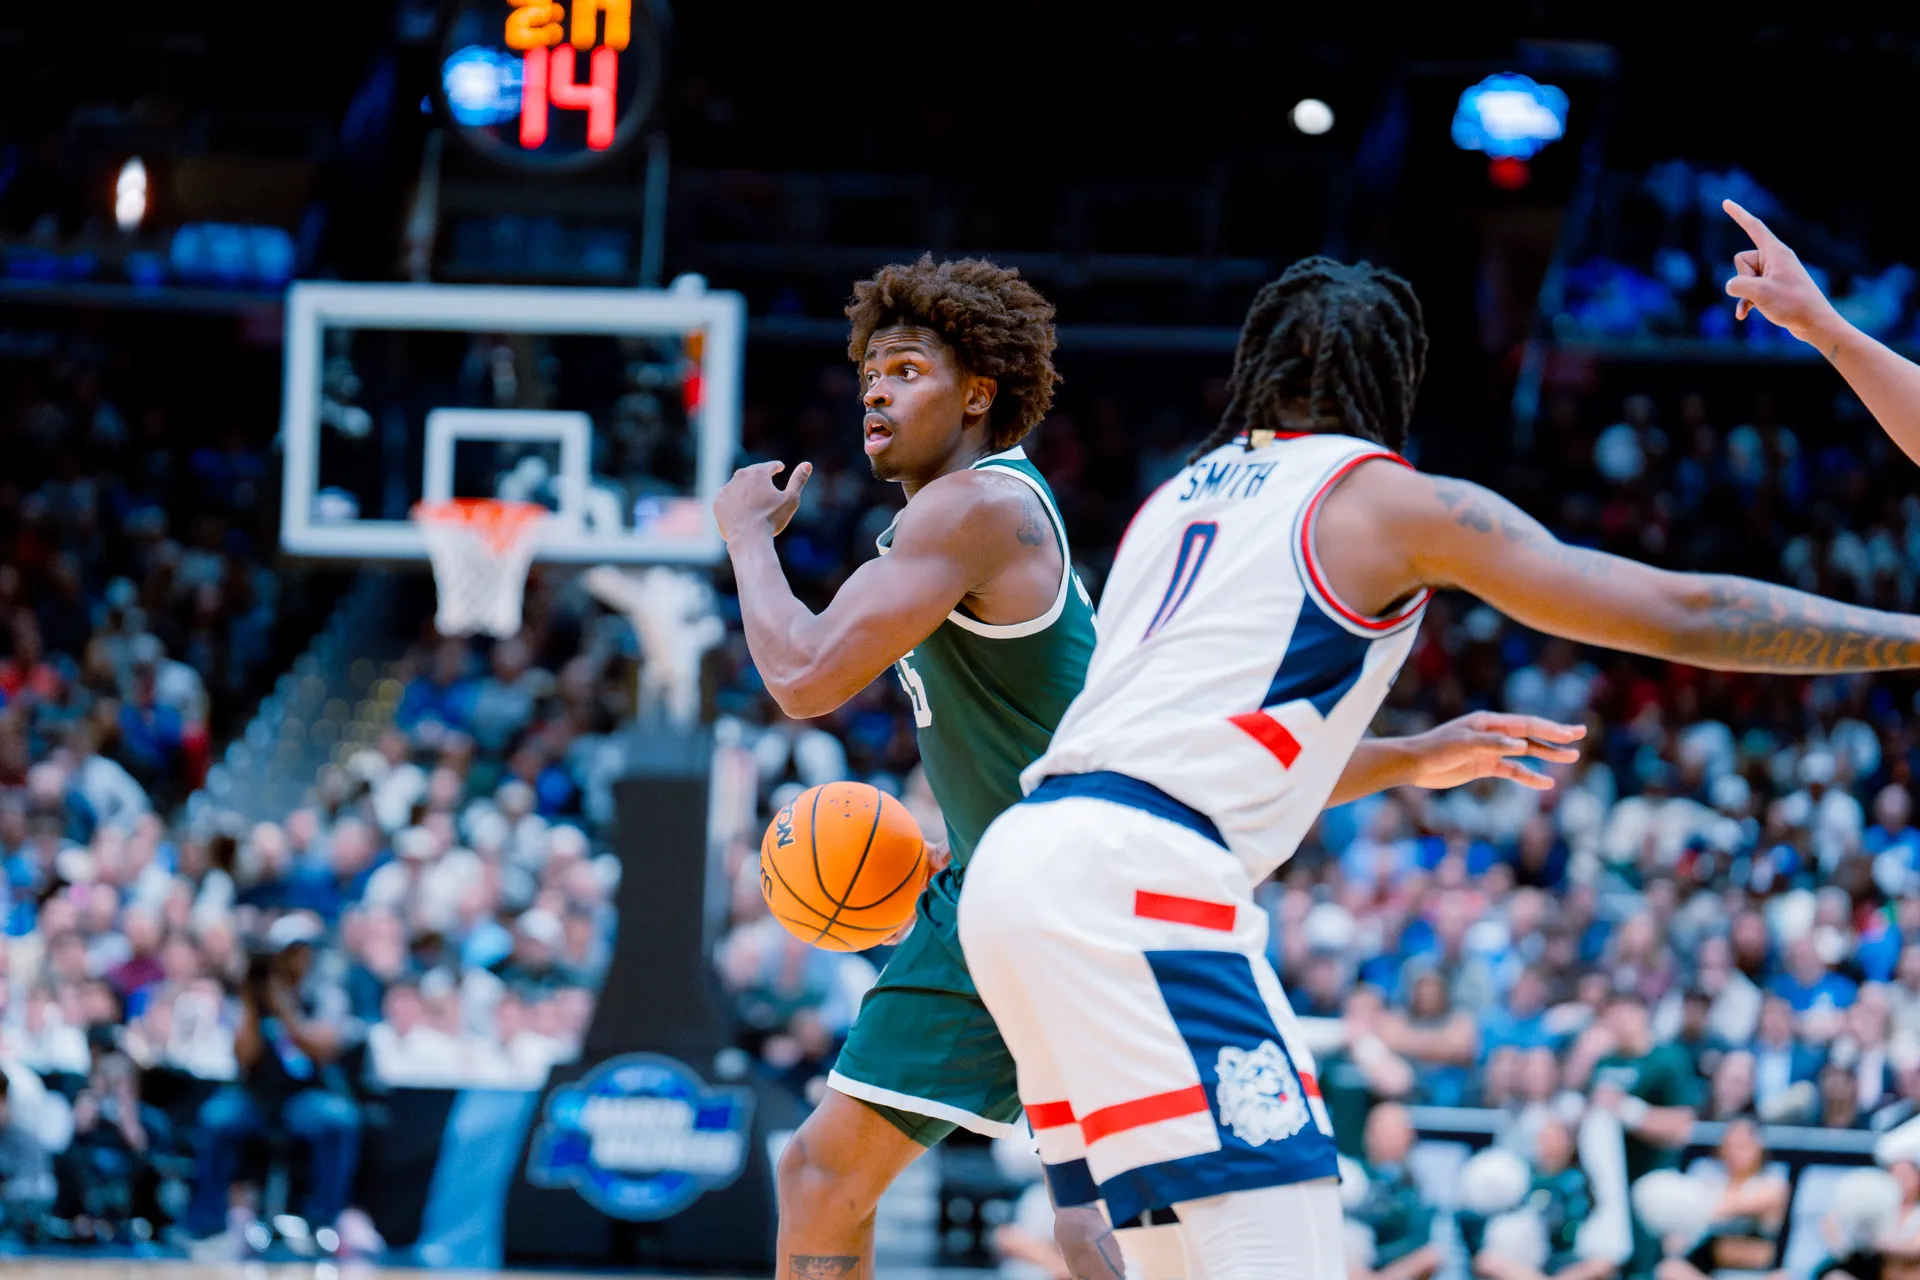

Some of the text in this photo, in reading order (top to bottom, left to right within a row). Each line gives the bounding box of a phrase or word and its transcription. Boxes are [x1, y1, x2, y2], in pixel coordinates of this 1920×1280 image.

[519, 43, 619, 151] 14
[1179, 462, 1279, 502] SMITH
[1139, 521, 1219, 645] 0
[896, 650, 932, 728] 5
